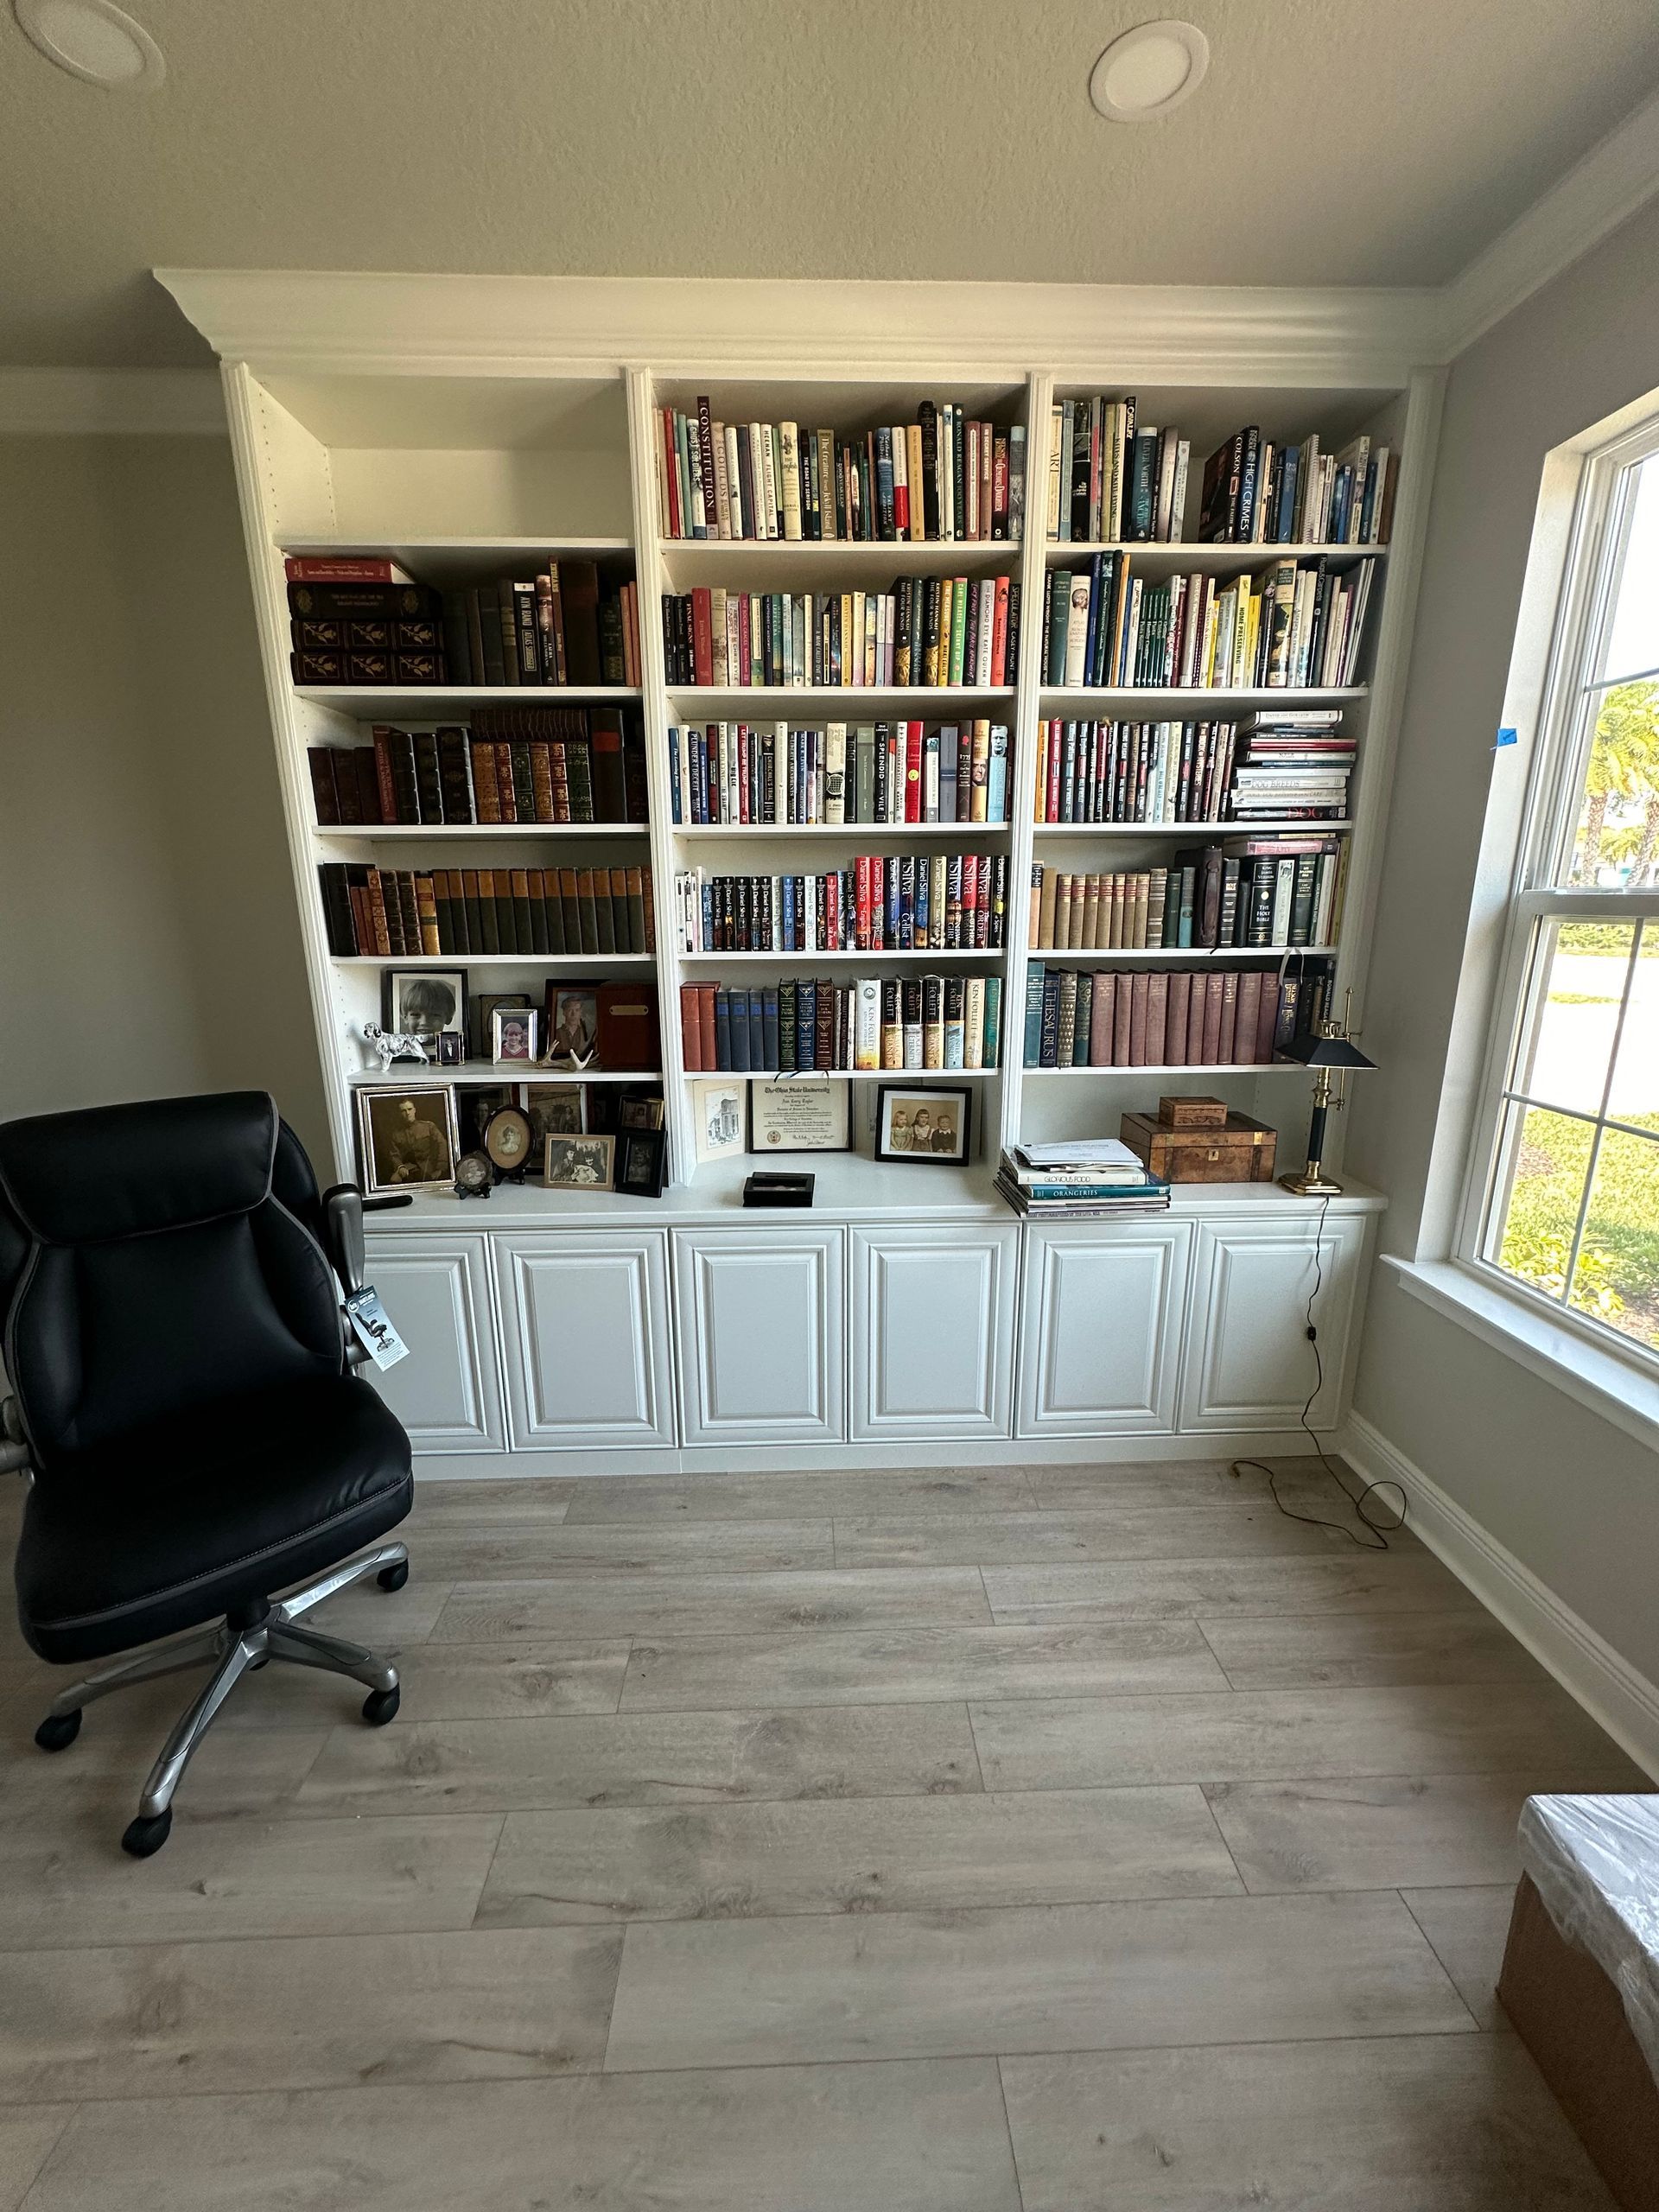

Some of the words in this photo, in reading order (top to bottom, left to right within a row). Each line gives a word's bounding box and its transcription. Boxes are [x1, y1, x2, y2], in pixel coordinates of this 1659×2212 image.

[689, 426, 700, 448] GHOST
[821, 438, 829, 449] The
[700, 407, 714, 508] CONSTITUTION
[1050, 449, 1059, 474] ART
[1142, 438, 1151, 462] OLIVER
[1233, 437, 1243, 473] COLSON
[691, 451, 700, 482] SOLDIERS
[717, 446, 728, 497] GOULDS
[1141, 464, 1151, 487] NORTH
[1244, 463, 1256, 489] HIGH
[821, 491, 831, 509] Jekyll
[1240, 491, 1253, 530] CRIMES
[824, 511, 833, 529] Island
[521, 597, 531, 608] AYN
[1010, 586, 1019, 629] SPECULATOR
[522, 610, 532, 626] RAND
[525, 646, 534, 669] SHRUGGED
[1235, 626, 1244, 664] PRESERVING
[1195, 757, 1205, 786] MYSTERIES
[1287, 807, 1323, 819] DOG
[902, 865, 914, 895] Silva
[948, 865, 960, 895] Silva
[963, 864, 975, 895] Silva
[978, 864, 990, 894] Silva
[997, 858, 1005, 881] Daniel
[859, 884, 867, 902] Silva
[873, 884, 881, 901] Silva
[919, 882, 927, 900] Silva
[996, 882, 1004, 899] Silva
[901, 913, 910, 938] Cellist
[1043, 990, 1056, 1057] THESAURUS
